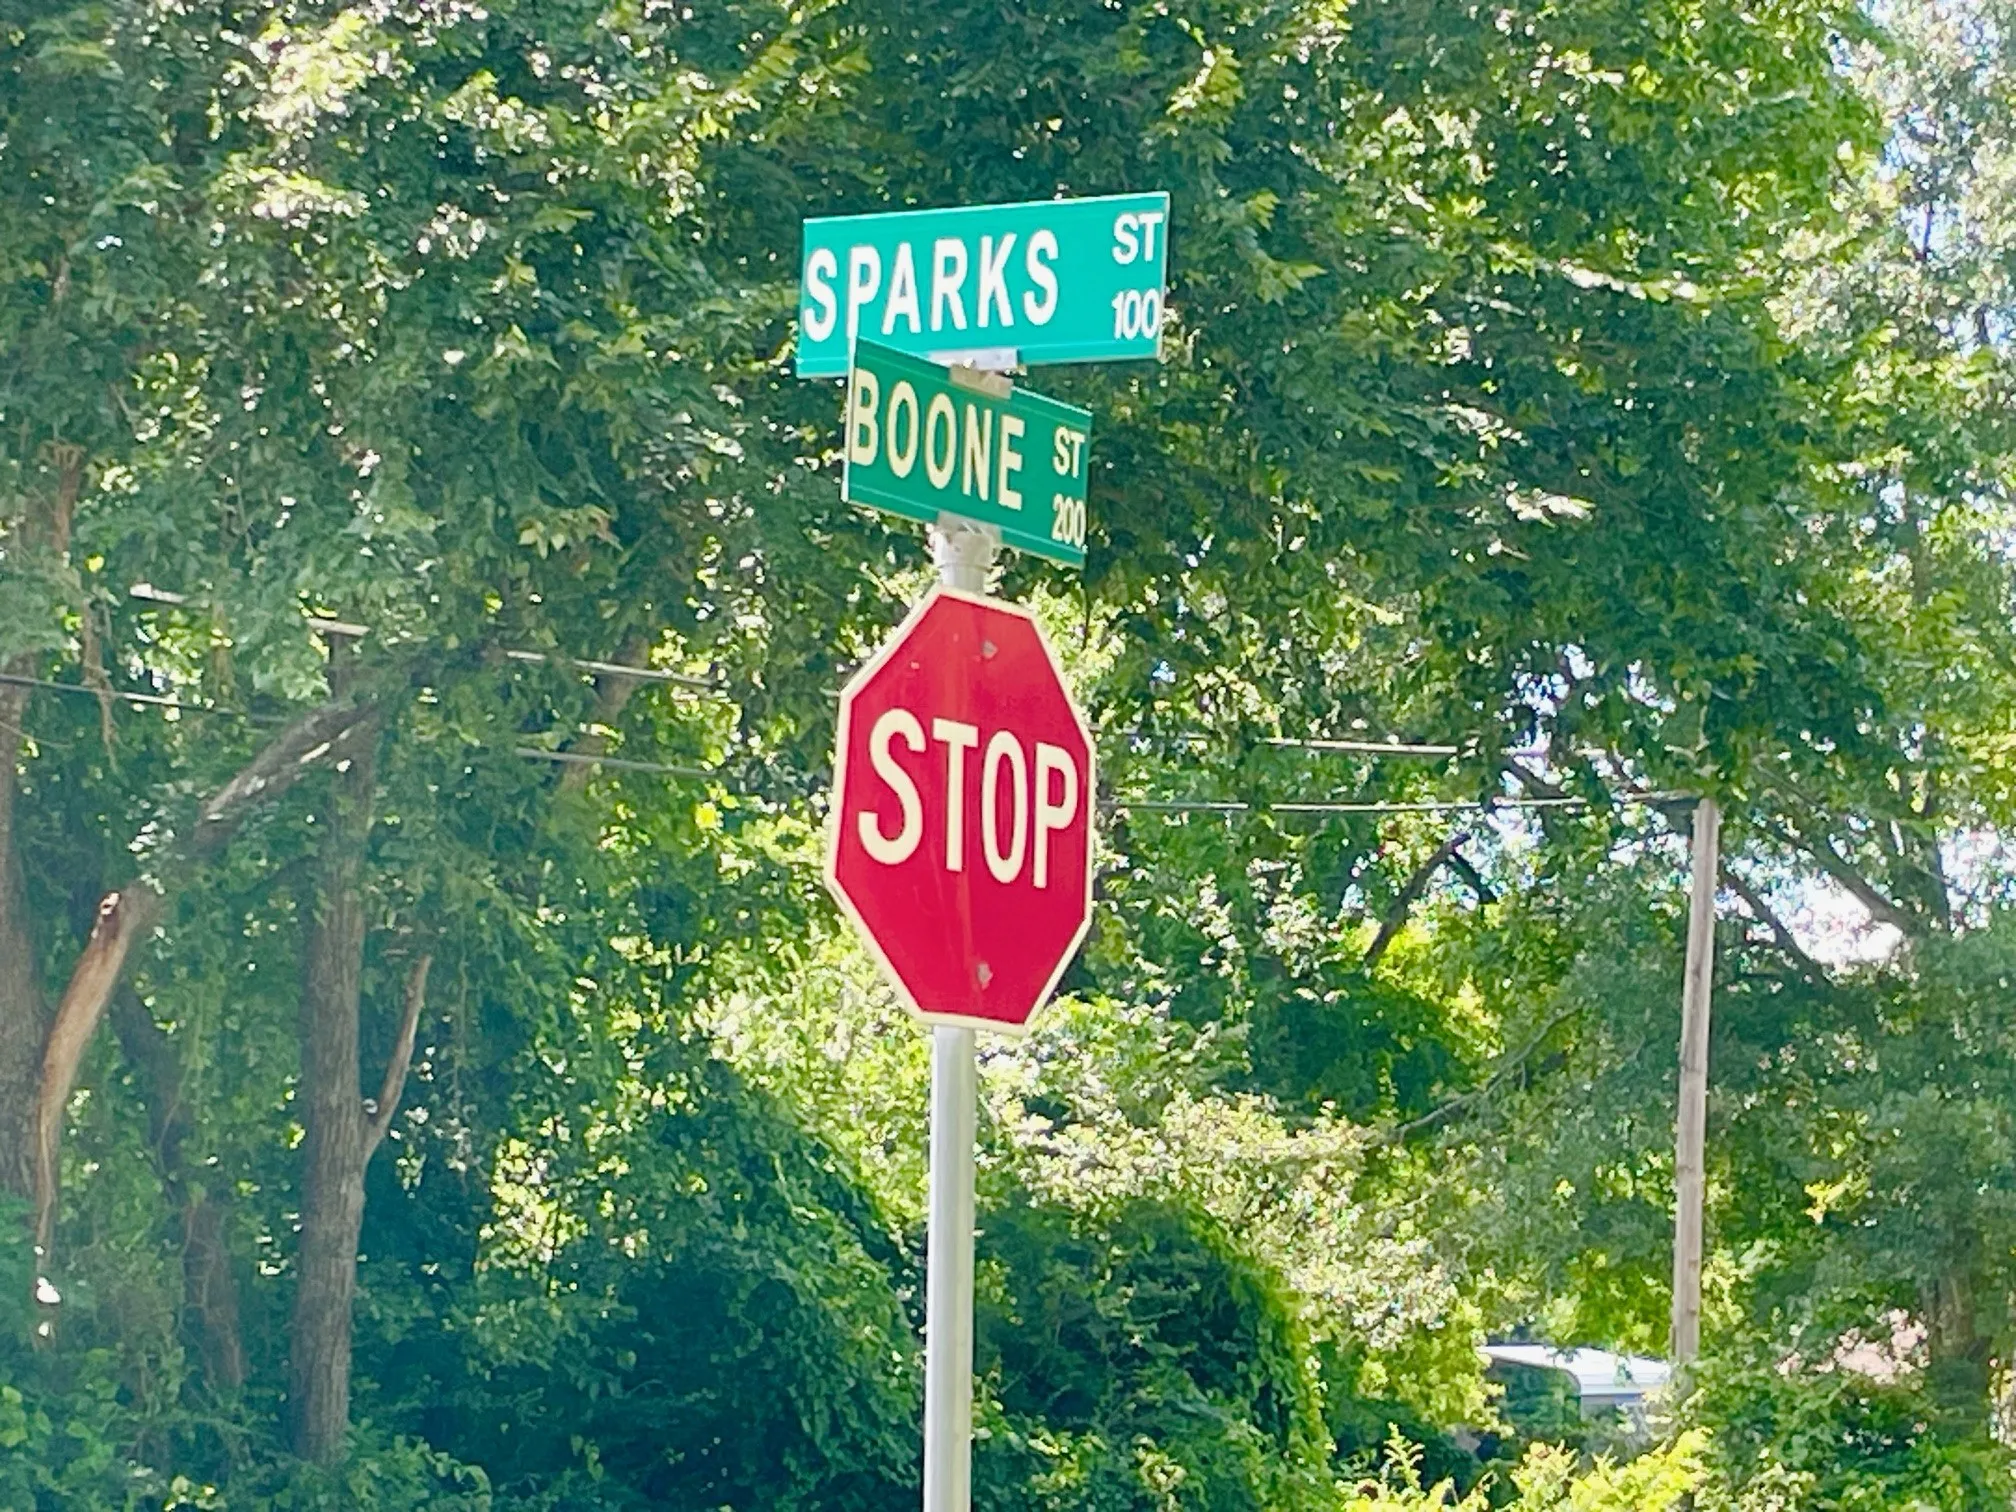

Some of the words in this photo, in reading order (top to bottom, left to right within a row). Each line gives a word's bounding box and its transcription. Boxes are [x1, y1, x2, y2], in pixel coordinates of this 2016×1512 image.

[803, 229, 1060, 343] SPARKS
[1111, 211, 1164, 265] ST
[1111, 288, 1160, 340] 100
[850, 367, 1026, 511] BOONE
[1053, 426, 1086, 479] ST
[1051, 493, 1087, 549] 200
[857, 707, 1079, 889] STOP
